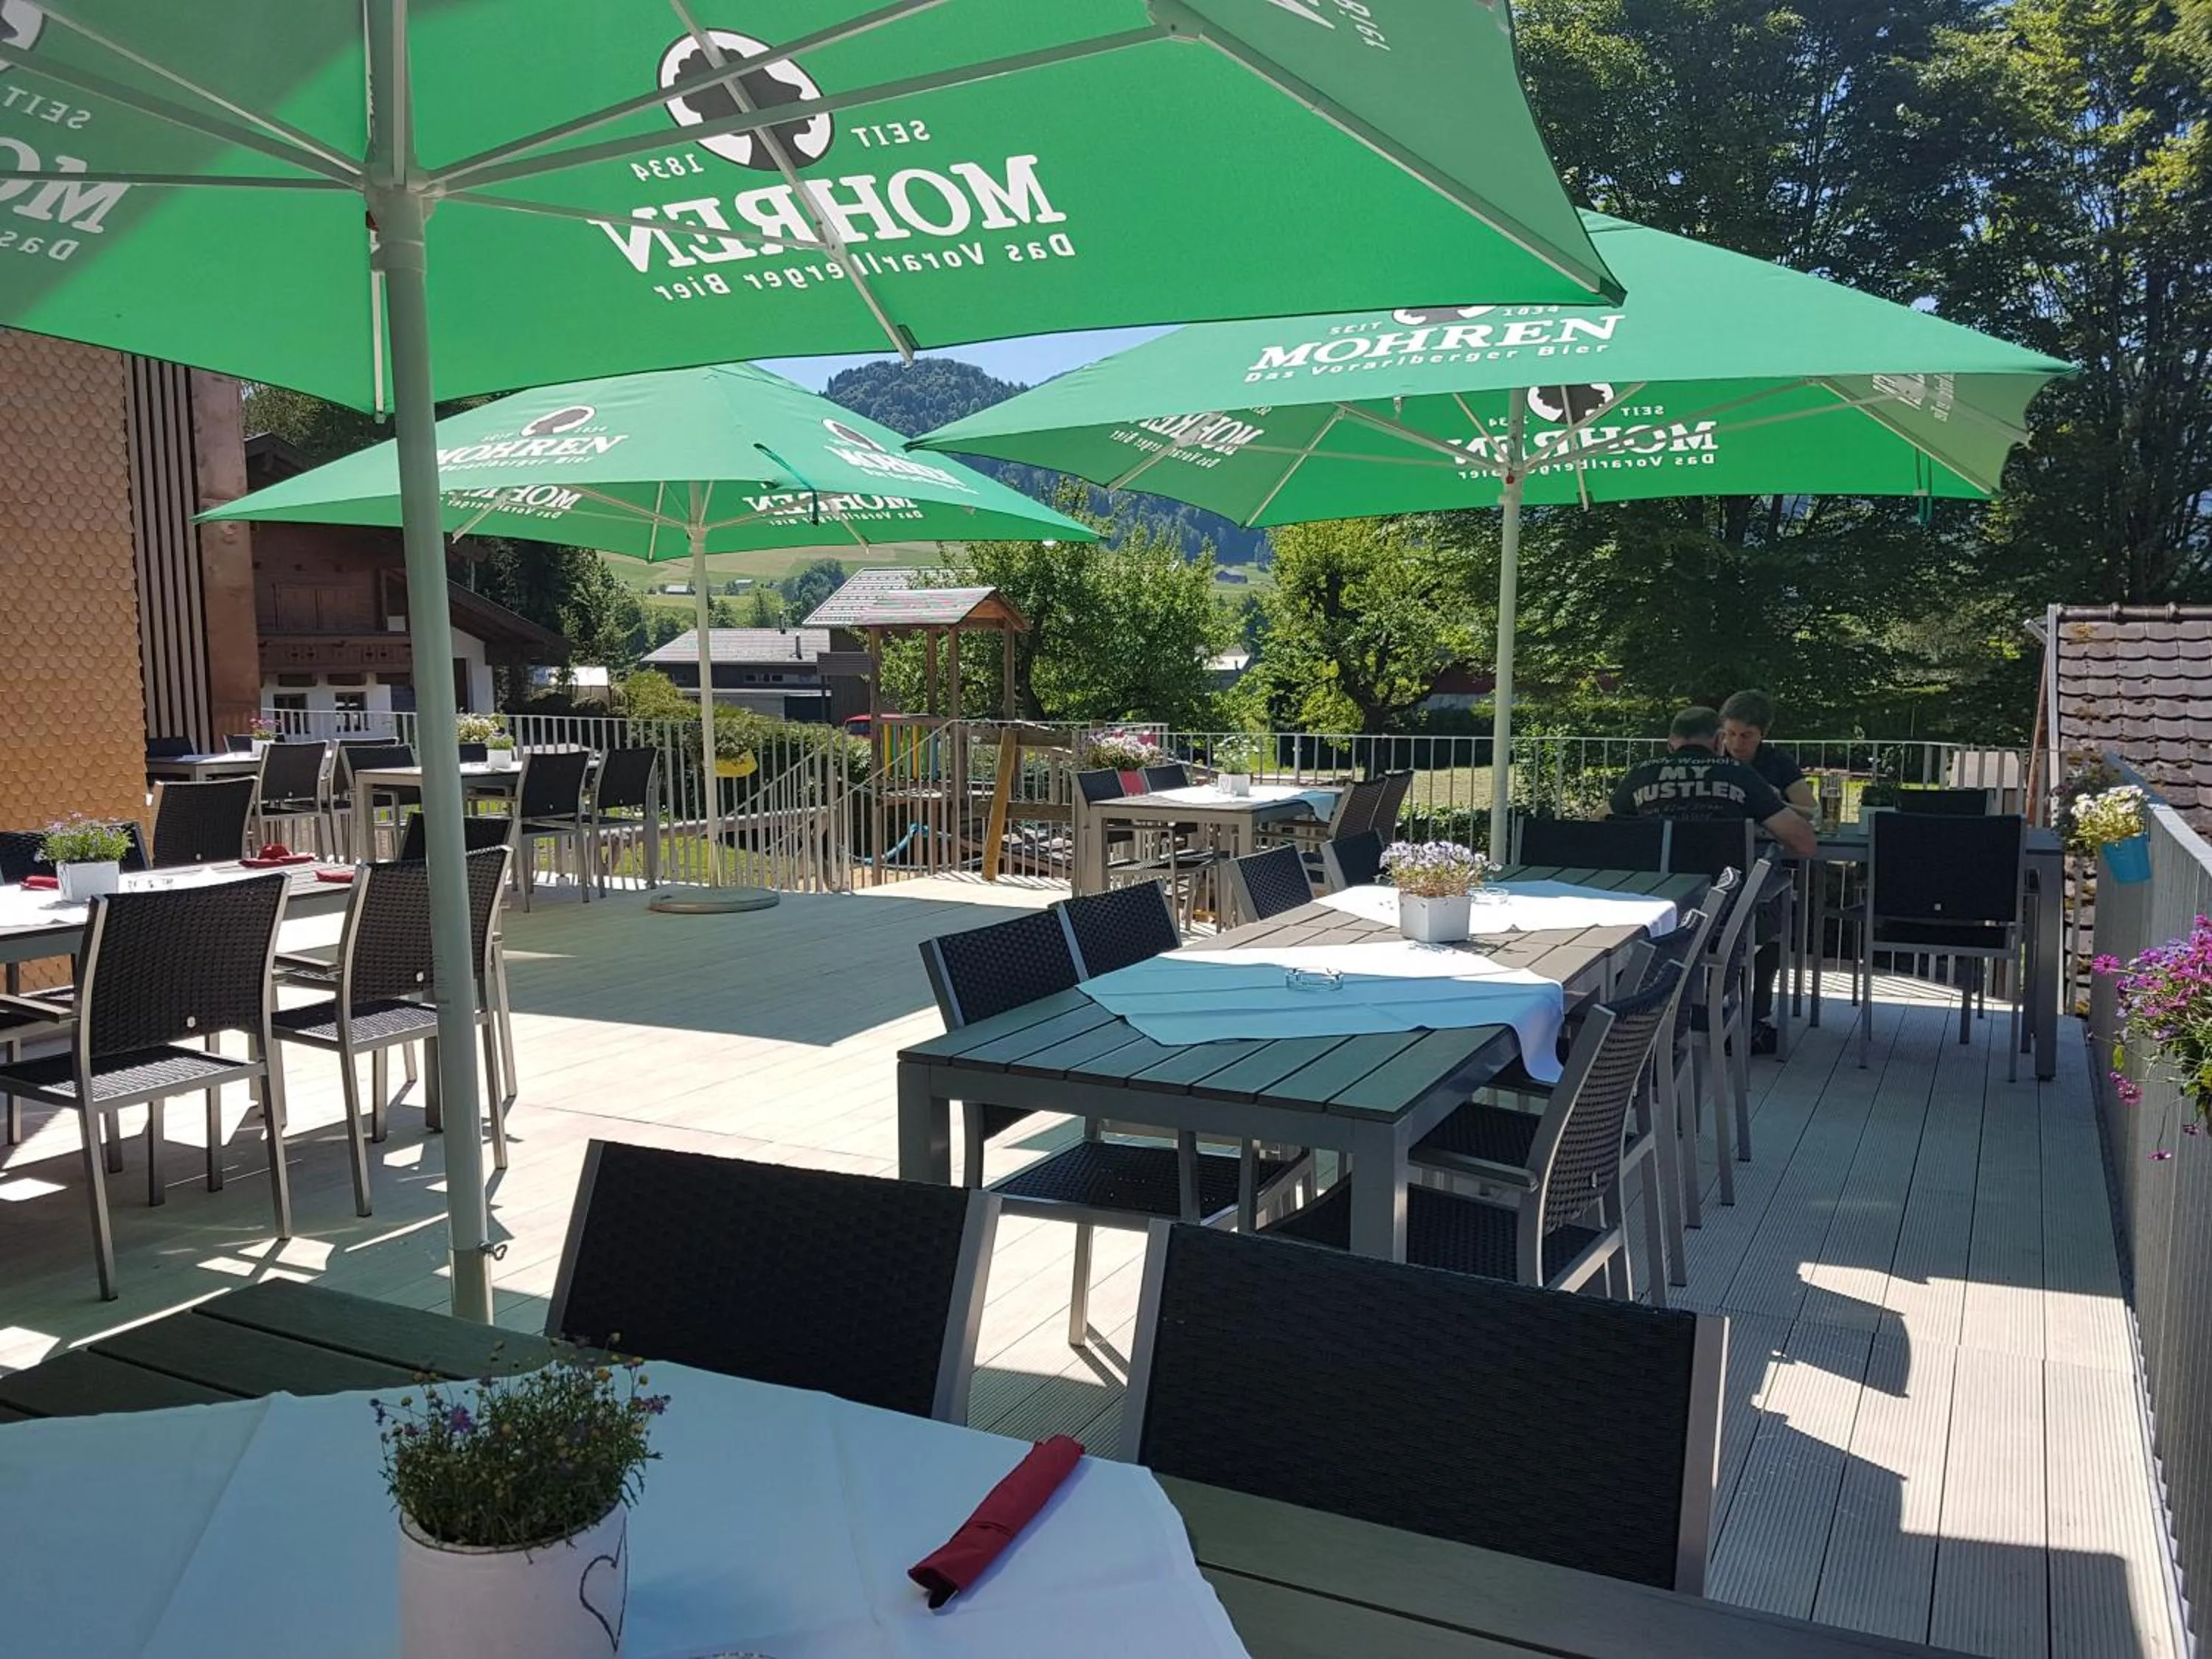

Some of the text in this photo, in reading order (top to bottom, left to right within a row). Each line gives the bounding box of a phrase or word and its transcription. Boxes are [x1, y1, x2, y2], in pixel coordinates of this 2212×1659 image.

[1329, 321, 1383, 335] SEIT
[1248, 315, 1626, 370] MOHREN
[1244, 344, 1610, 383] Das Vorarlberger Bier
[1658, 765, 1712, 781] MY
[1632, 781, 1747, 807] HUSTLER
